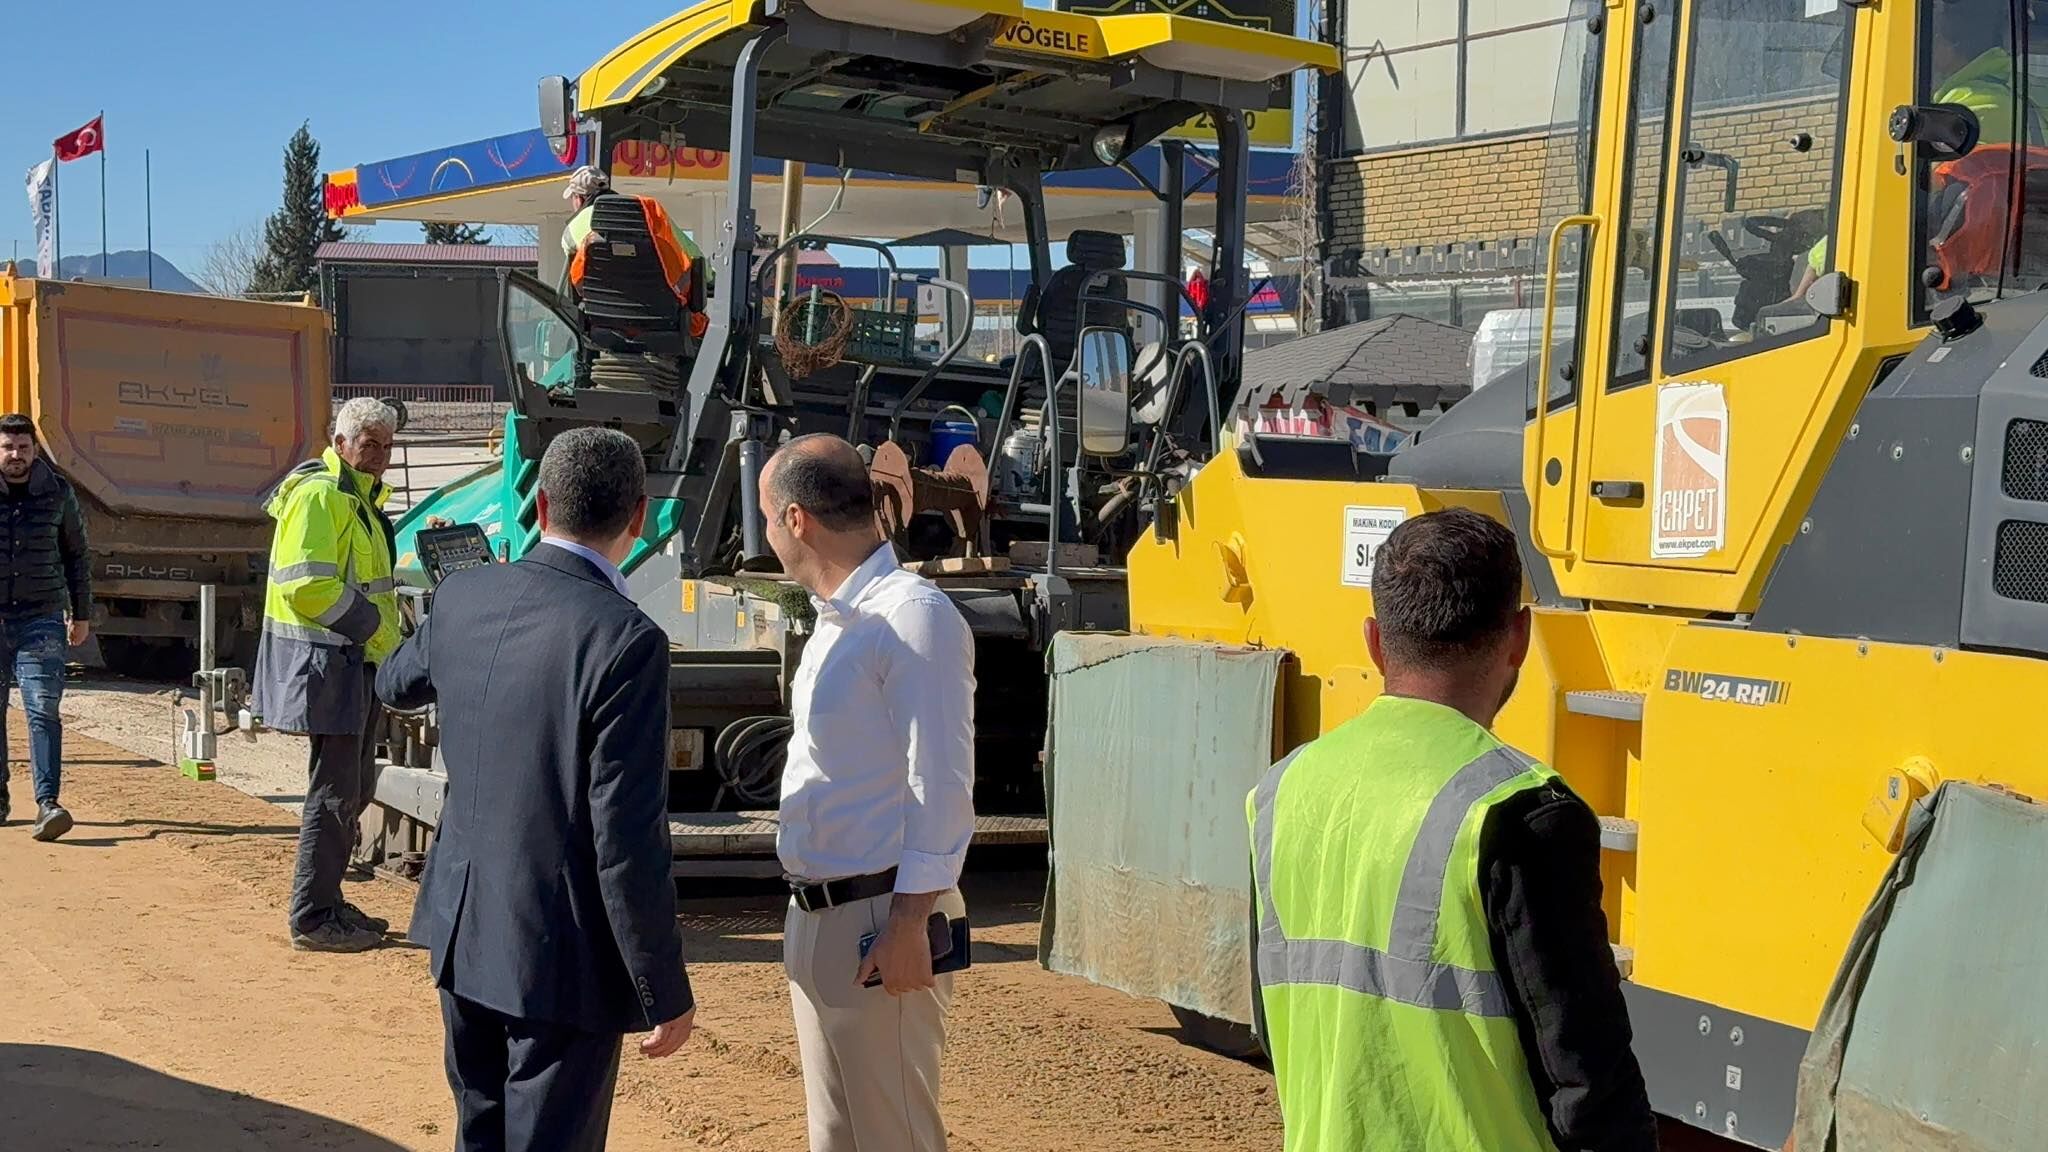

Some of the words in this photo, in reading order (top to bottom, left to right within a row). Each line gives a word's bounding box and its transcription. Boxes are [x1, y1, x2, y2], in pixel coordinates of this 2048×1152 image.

[1005, 20, 1089, 53] VÖGELE
[118, 380, 249, 409] AKYEL
[1661, 488, 1717, 533] EKPET
[1659, 539, 1717, 550] www.ekpet.com
[1735, 682, 1769, 706] RH
